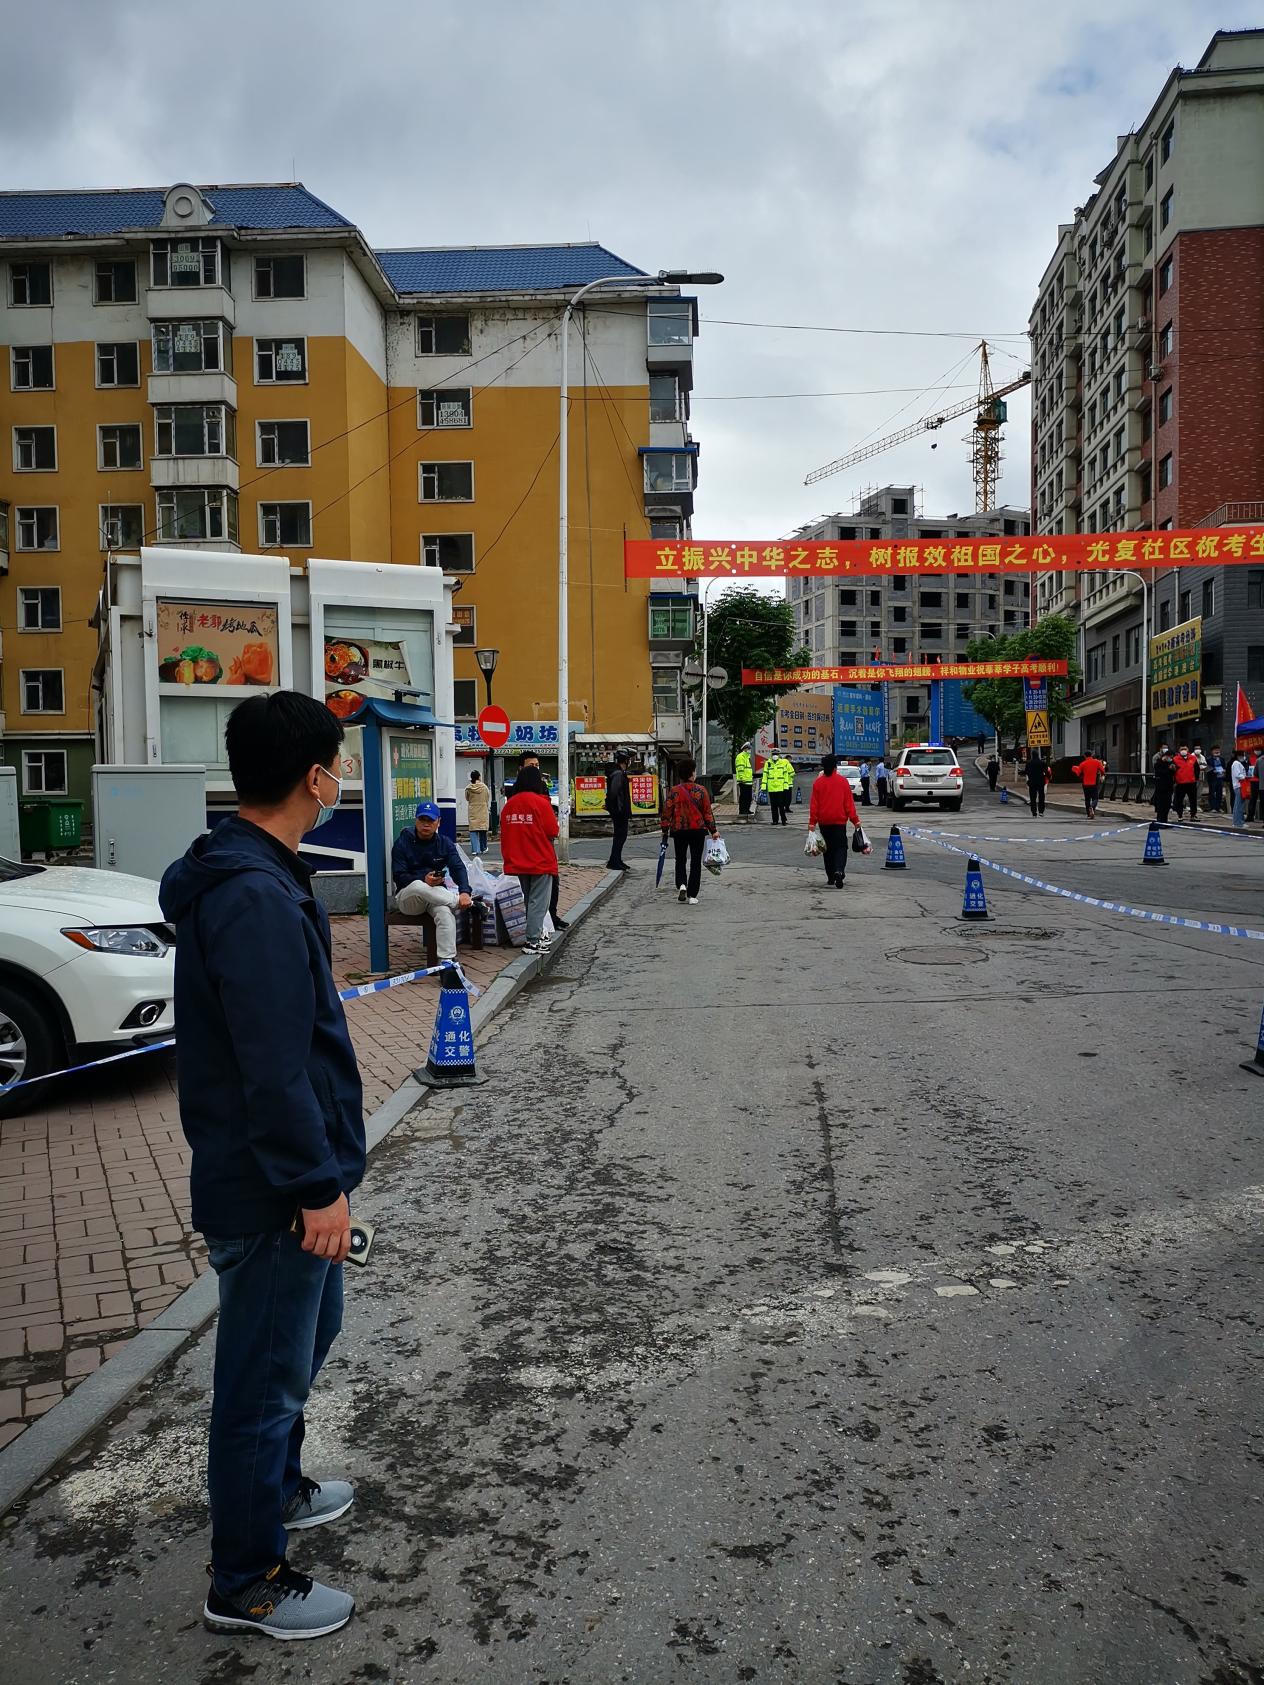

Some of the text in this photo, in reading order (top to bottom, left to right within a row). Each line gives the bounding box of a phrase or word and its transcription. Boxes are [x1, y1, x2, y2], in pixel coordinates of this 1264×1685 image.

[372, 658, 407, 671] 黑椒牛
[455, 725, 558, 741] 牧奶坊
[444, 1030, 470, 1043] 通化
[444, 1045, 470, 1057] 交警
